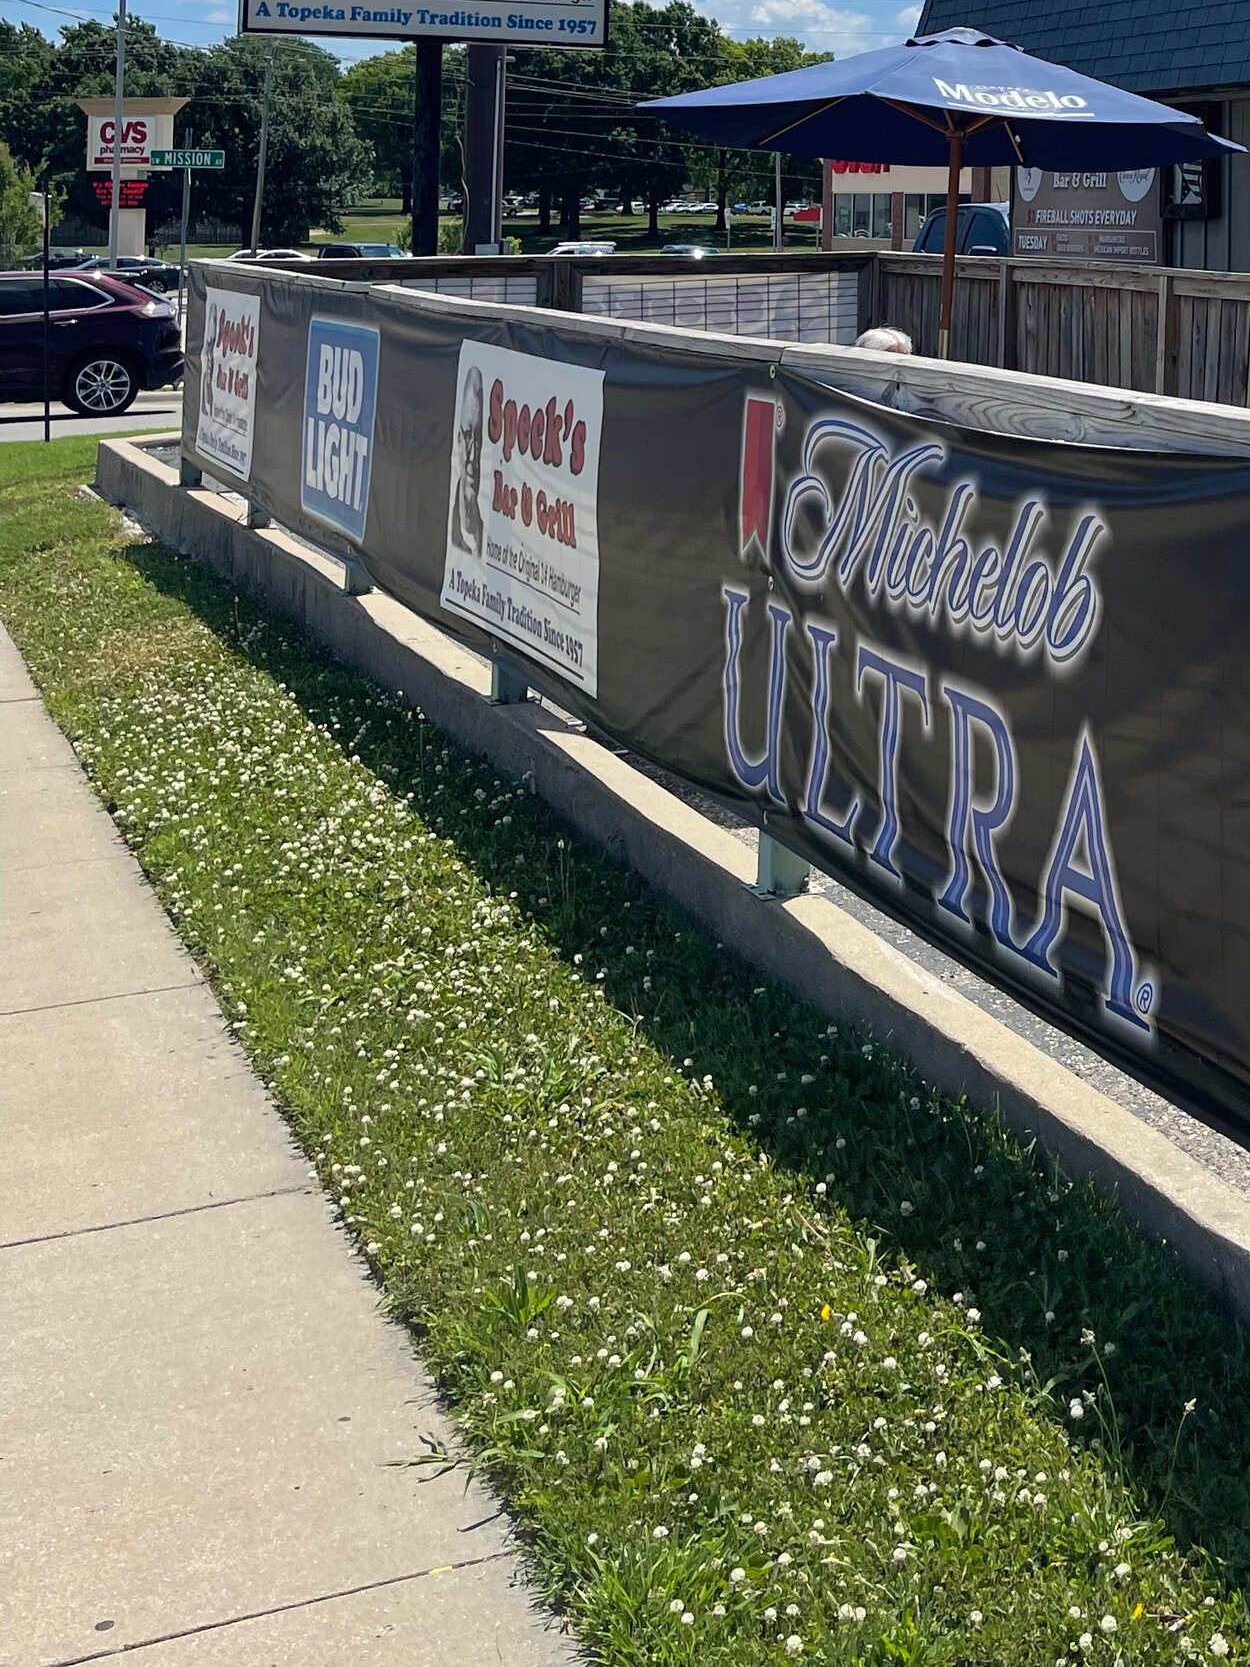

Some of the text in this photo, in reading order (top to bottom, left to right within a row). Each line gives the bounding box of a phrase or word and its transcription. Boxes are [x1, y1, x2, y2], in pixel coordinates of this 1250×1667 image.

[255, 1, 597, 35] A Topeka Family Tradition Since 1957
[931, 77, 1088, 108] Modelo
[100, 121, 147, 144] CVS
[100, 145, 145, 155] phamacy
[164, 152, 212, 165] MISSION
[1053, 172, 1070, 188] Bar
[1071, 172, 1081, 188] &
[1083, 172, 1107, 188] Grill
[1036, 209, 1069, 224] FIREBALL
[1070, 210, 1094, 225] SHOTS
[1095, 210, 1137, 226] EVERYDAY
[1018, 235, 1048, 250] TUESDAY
[317, 343, 364, 424] BUD
[488, 378, 586, 476] Speck's
[306, 417, 368, 512] LIGHT
[492, 469, 577, 549] Bar & Grill
[783, 419, 1104, 663] Michelob
[519, 551, 540, 582] Original
[548, 565, 581, 608] Hamburger
[449, 568, 583, 668] A Topeka Family Tradition Since 1957
[723, 587, 1151, 1033] ULTRA
